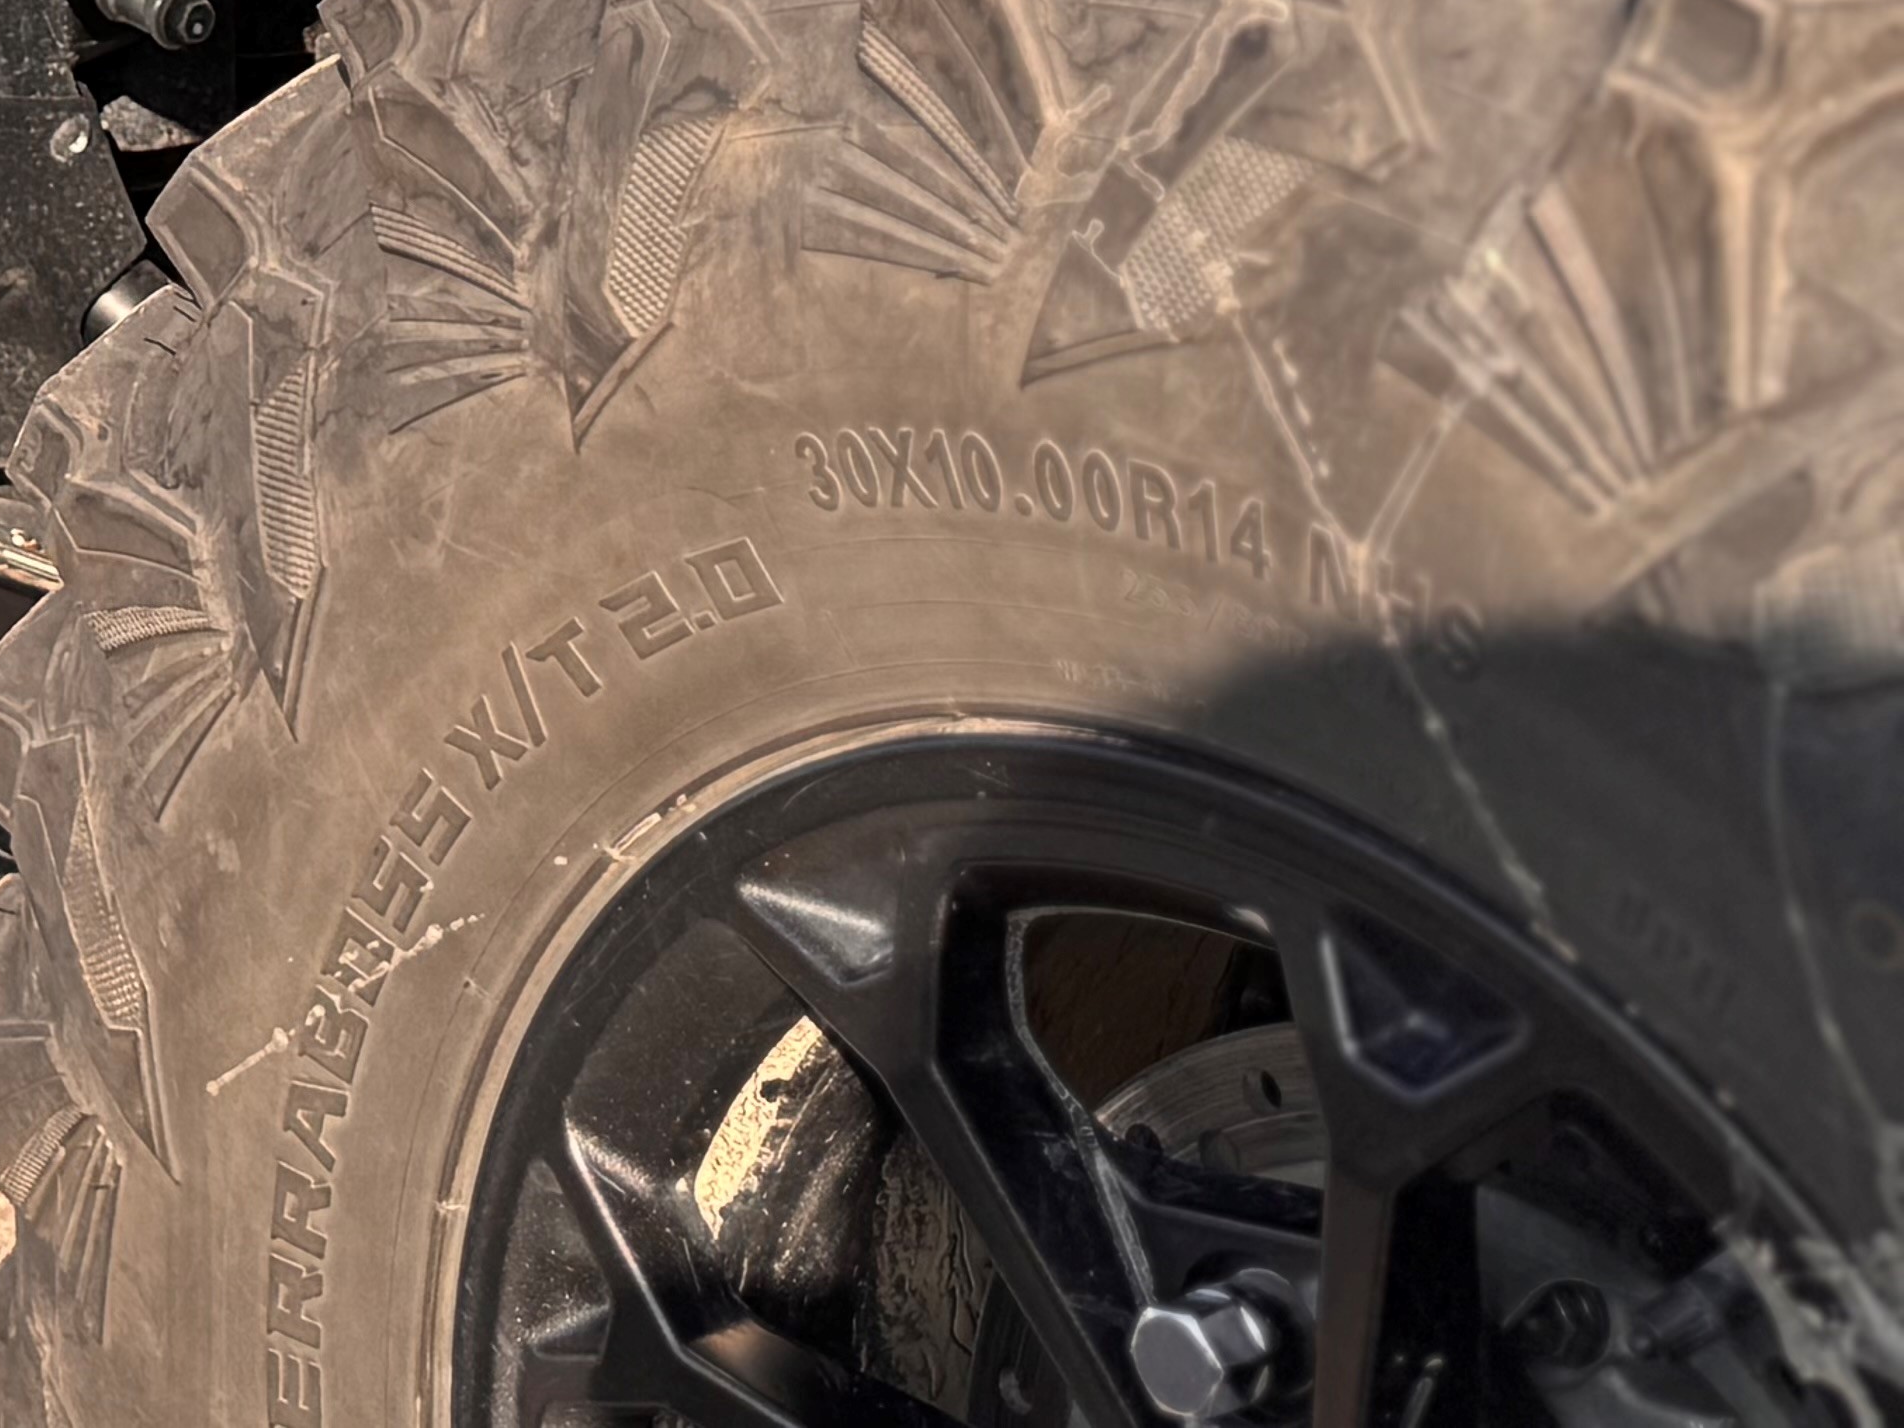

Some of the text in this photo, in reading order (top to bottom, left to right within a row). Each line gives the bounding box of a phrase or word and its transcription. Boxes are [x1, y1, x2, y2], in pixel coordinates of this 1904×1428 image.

[795, 427, 1272, 581] 30X10.00R14
[443, 616, 603, 791] X/T
[600, 535, 784, 661] 2.0
